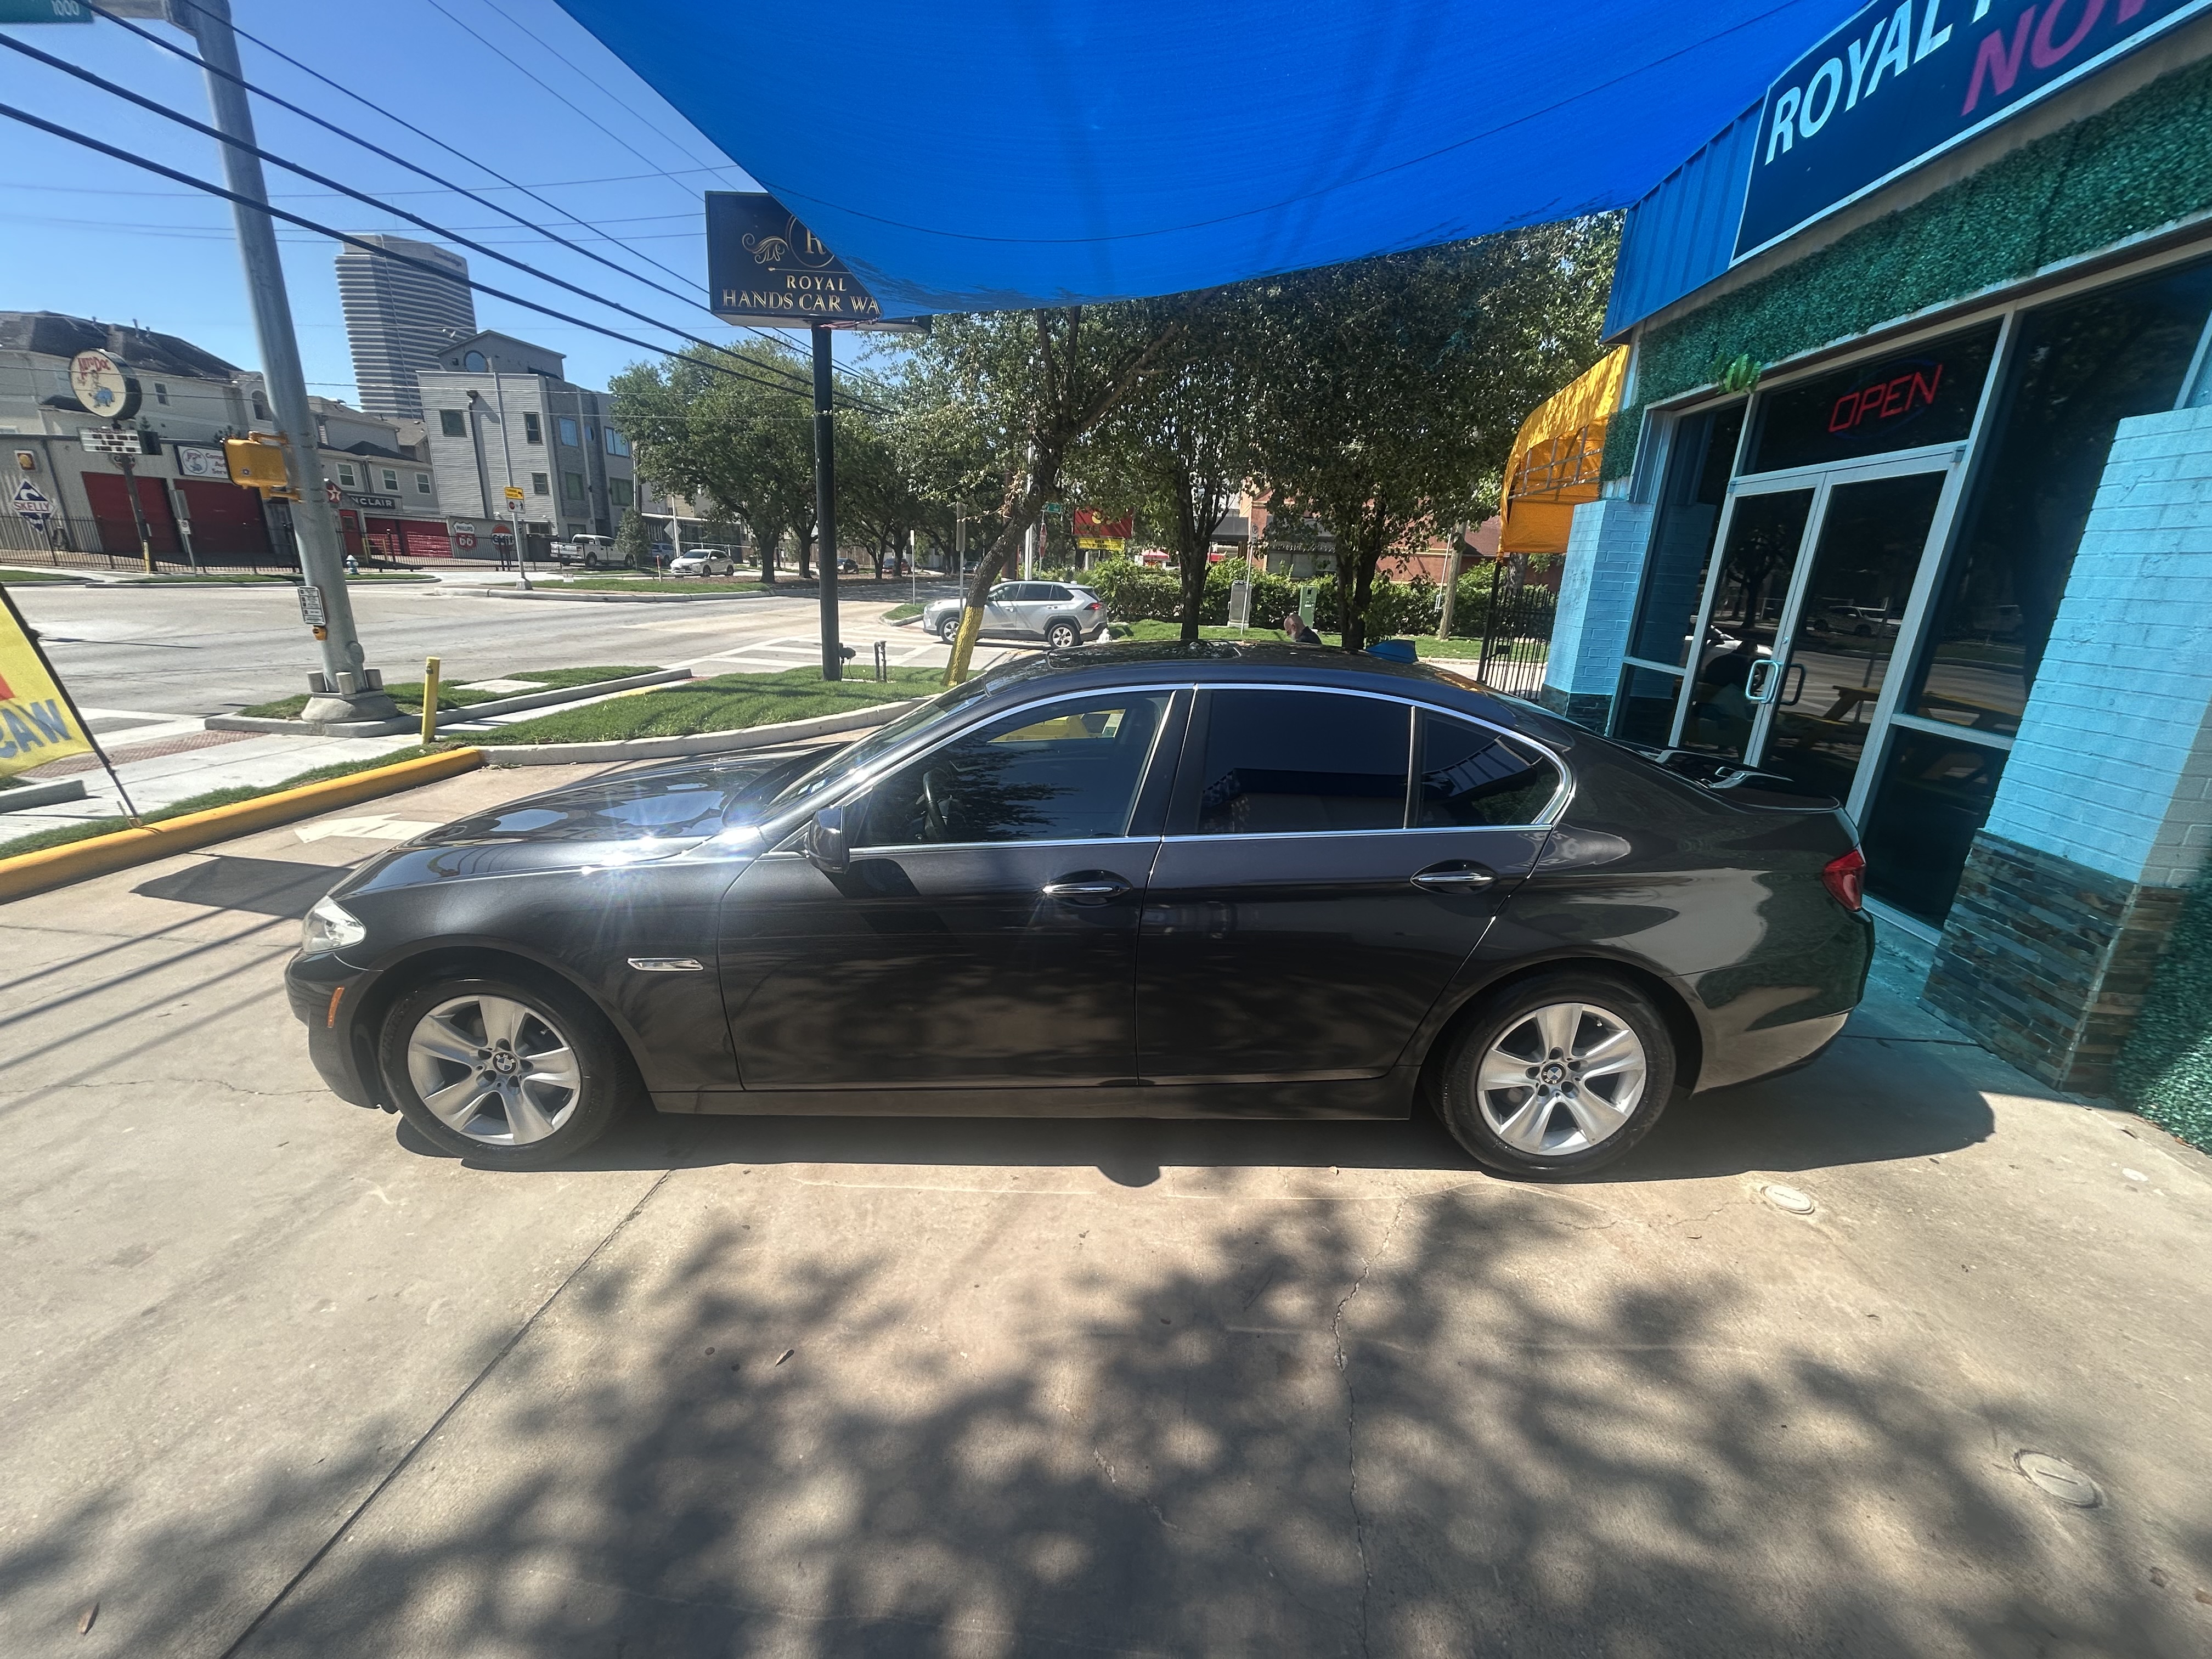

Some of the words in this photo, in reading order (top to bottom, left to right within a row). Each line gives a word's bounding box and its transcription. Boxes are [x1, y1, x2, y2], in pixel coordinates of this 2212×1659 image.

[1961, 0, 2146, 117] NO
[1765, 0, 1953, 166] ROYAL
[723, 289, 794, 309] HANDS
[799, 294, 843, 312] CAR
[786, 275, 847, 291] ROYAL
[1828, 364, 1943, 432] OPEN
[14, 502, 49, 512] SKELLY
